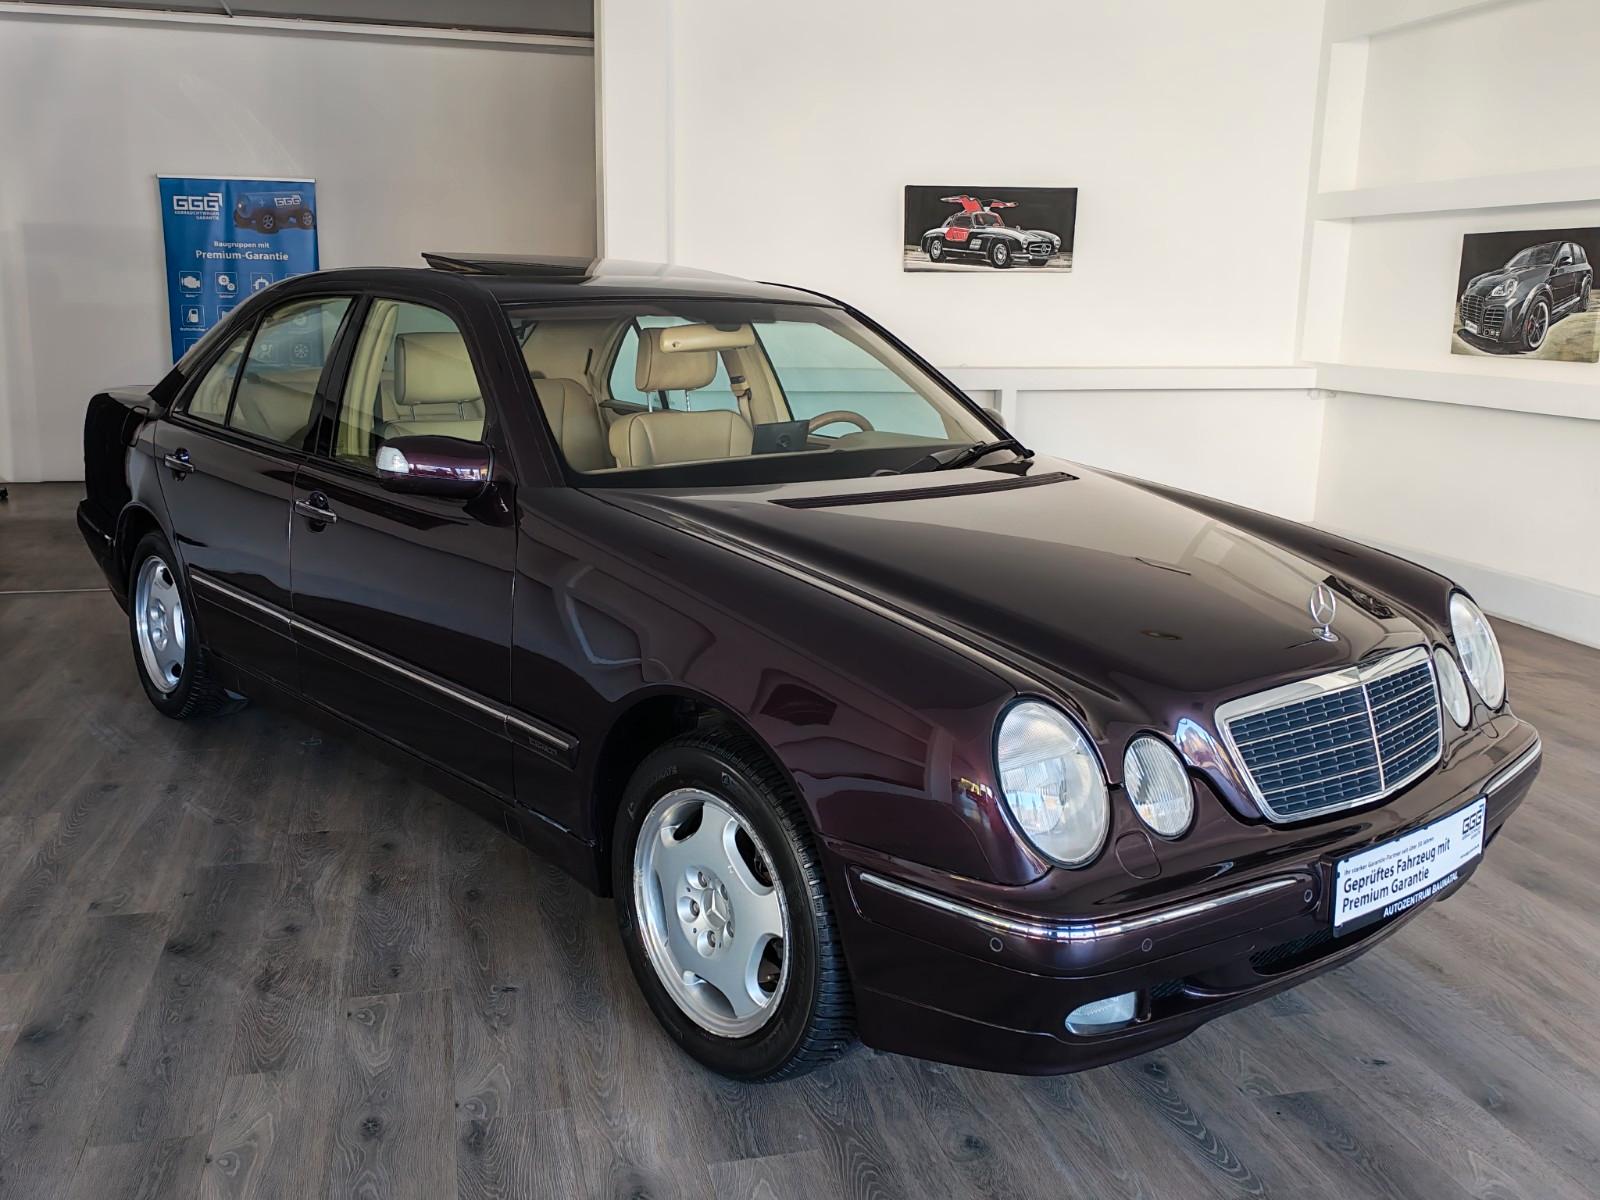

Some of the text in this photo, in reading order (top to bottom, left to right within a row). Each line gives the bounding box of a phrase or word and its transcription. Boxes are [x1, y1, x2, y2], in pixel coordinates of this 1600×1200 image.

[173, 193, 222, 211] GGG
[195, 250, 289, 261] Premium-Garantie
[213, 241, 257, 249] Baugruppen
[1462, 804, 1484, 835] GGG
[1343, 865, 1395, 894] Geprüftes
[1396, 847, 1436, 873] Fahrzeug
[1437, 837, 1451, 854] mit
[1342, 867, 1430, 913] Premium Garantie
[1383, 871, 1459, 918] AUTOZENTRUM BAUNATAL
